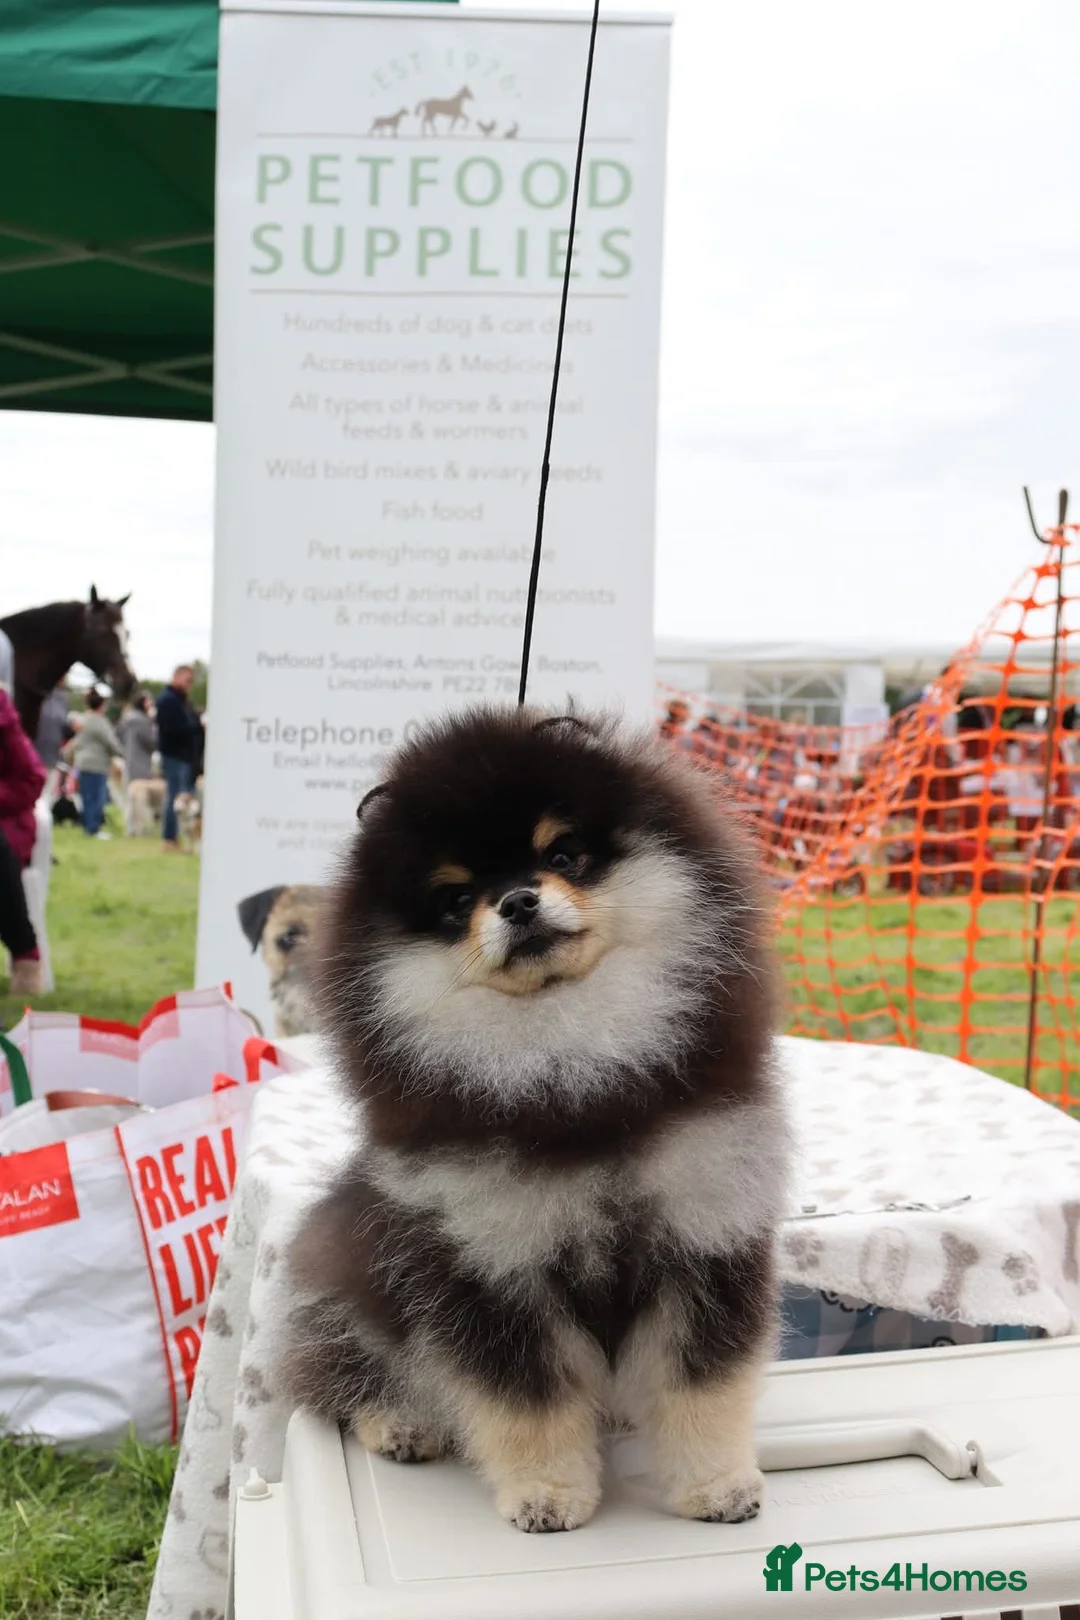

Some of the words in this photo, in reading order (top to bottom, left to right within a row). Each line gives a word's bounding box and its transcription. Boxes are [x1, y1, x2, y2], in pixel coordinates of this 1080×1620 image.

[256, 154, 633, 209] PETFOOD
[250, 222, 632, 280] SUPPLIES
[283, 311, 393, 335] Hundreds
[398, 312, 422, 335] of
[426, 313, 472, 338] dog
[478, 313, 495, 335] &
[501, 317, 535, 335] cat
[539, 314, 594, 336] dets
[300, 351, 432, 375] Accessories
[437, 352, 454, 374] &
[287, 392, 319, 413] All
[323, 394, 384, 420] types
[390, 393, 414, 414] of
[418, 393, 481, 415] horse
[486, 393, 503, 414] &
[342, 418, 402, 440] feeds
[408, 420, 425, 440] &
[432, 423, 529, 441] wormers
[265, 457, 317, 479] Wild
[323, 458, 369, 480] bird
[374, 459, 438, 481] mixes
[444, 459, 461, 480] &
[467, 459, 531, 487] aviary
[544, 461, 604, 482] eeds
[381, 500, 426, 521] Fish
[431, 501, 484, 522] food
[307, 540, 342, 561] Pet
[347, 541, 451, 567] weighing
[457, 543, 557, 564] availabe
[246, 579, 298, 606] Fully
[302, 581, 399, 606] qualified
[405, 582, 479, 603] animal
[334, 606, 352, 626] &
[358, 607, 446, 627] medical
[452, 608, 525, 629] advice
[256, 651, 324, 670] Petfood
[327, 674, 433, 692] Lincolnshire
[442, 675, 487, 693] PE22
[241, 717, 394, 749] Telephone
[273, 752, 322, 769] Email
[0, 1178, 61, 1211] ALAN
[158, 1214, 229, 1318] LIF
